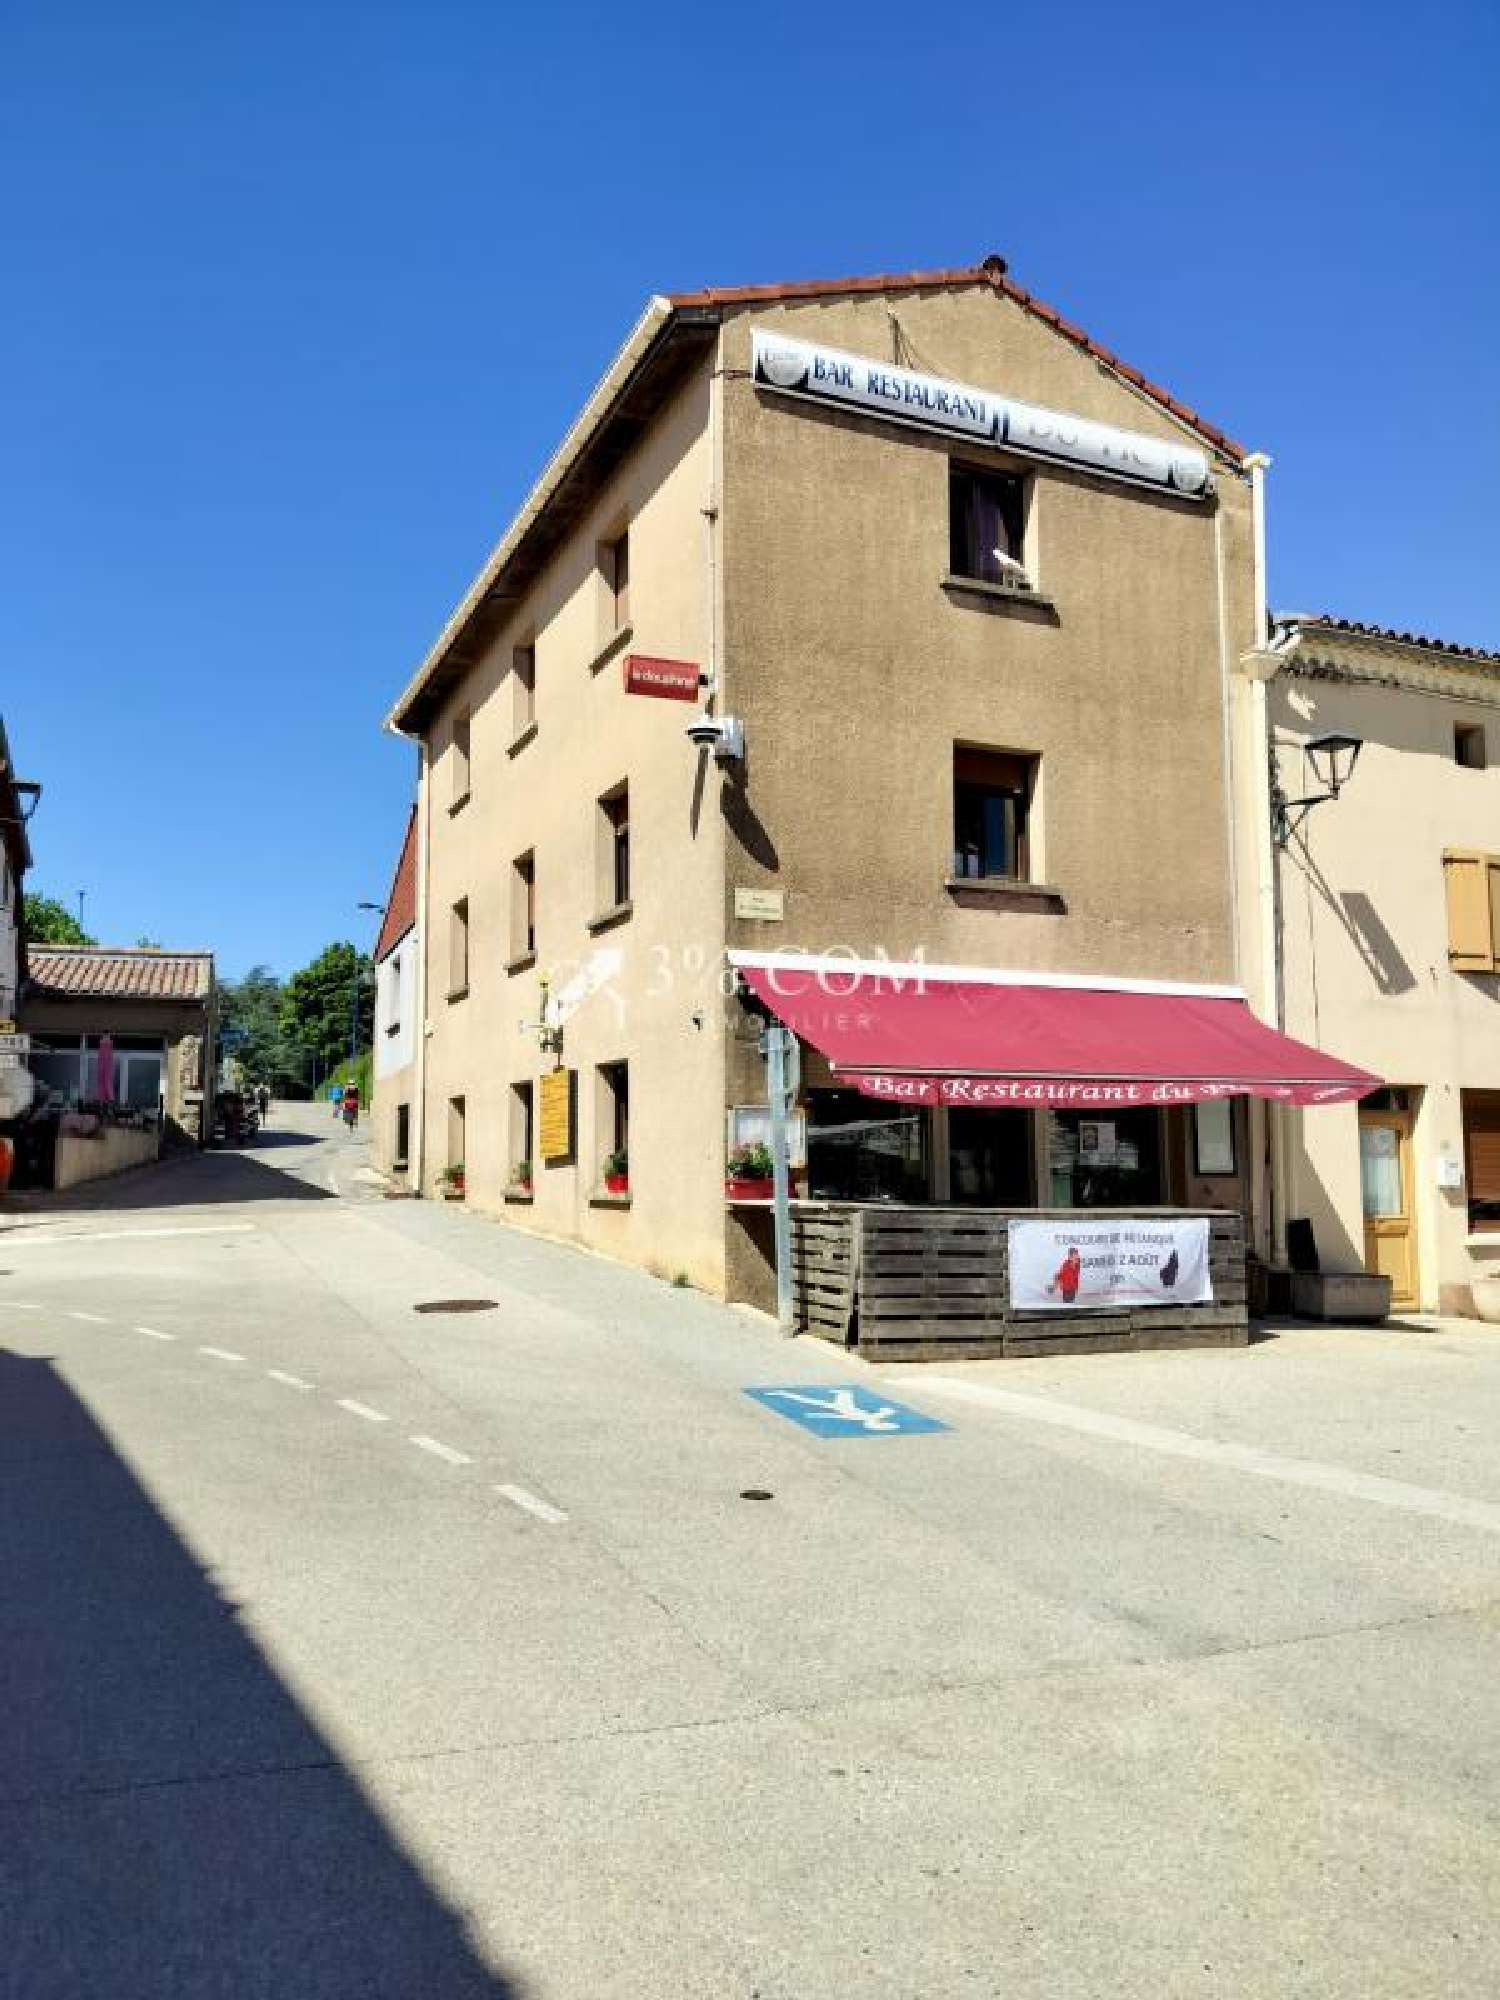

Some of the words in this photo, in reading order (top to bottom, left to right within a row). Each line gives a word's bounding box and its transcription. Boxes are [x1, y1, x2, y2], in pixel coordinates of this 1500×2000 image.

[814, 353, 853, 388] BAR
[868, 367, 986, 424] RESTAURANT
[863, 1077, 933, 1097] Bar
[942, 1078, 1141, 1101] Restaurant
[1152, 1082, 1193, 1101] du
